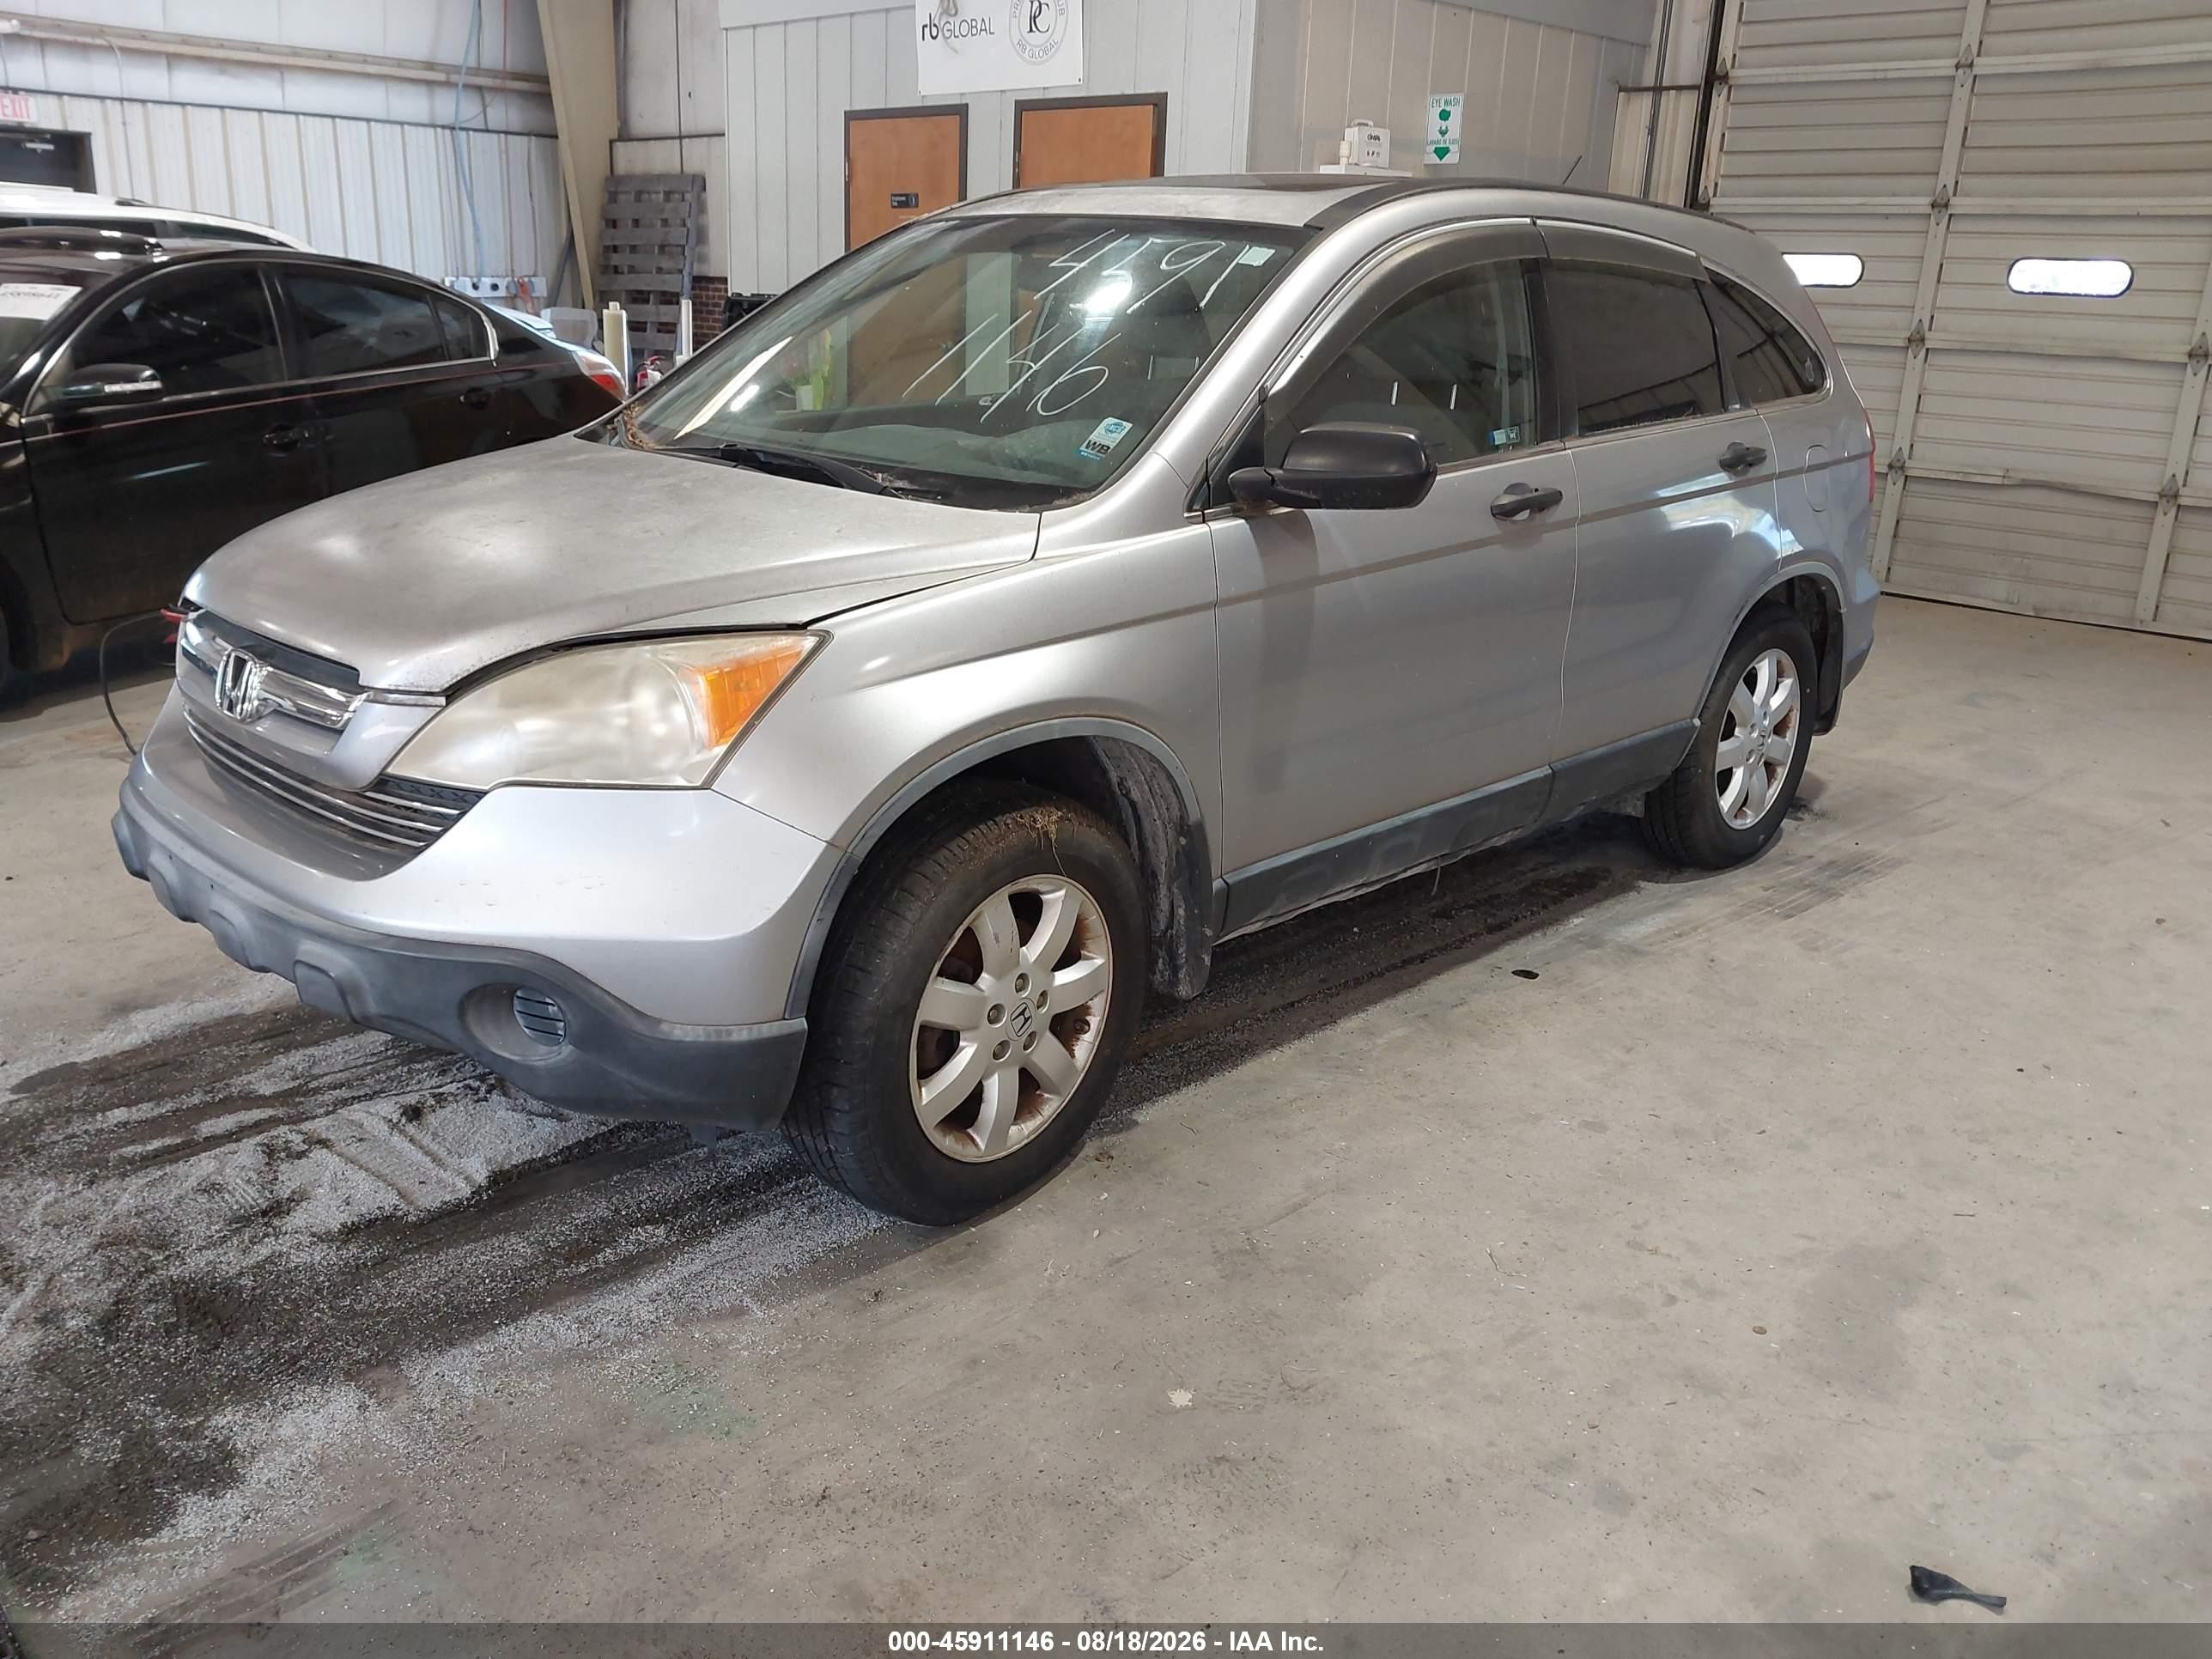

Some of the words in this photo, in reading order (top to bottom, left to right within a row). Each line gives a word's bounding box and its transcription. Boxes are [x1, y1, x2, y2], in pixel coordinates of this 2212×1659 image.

[942, 17, 995, 40] GLOBAL
[1017, 39, 1027, 54] RB
[1028, 40, 1058, 59] GLOBAL
[0, 95, 30, 118] EXIT
[1431, 98, 1442, 108] EYE
[1443, 96, 1461, 108] WASH
[902, 310, 1121, 424] 1146
[1085, 439, 1111, 455] WB
